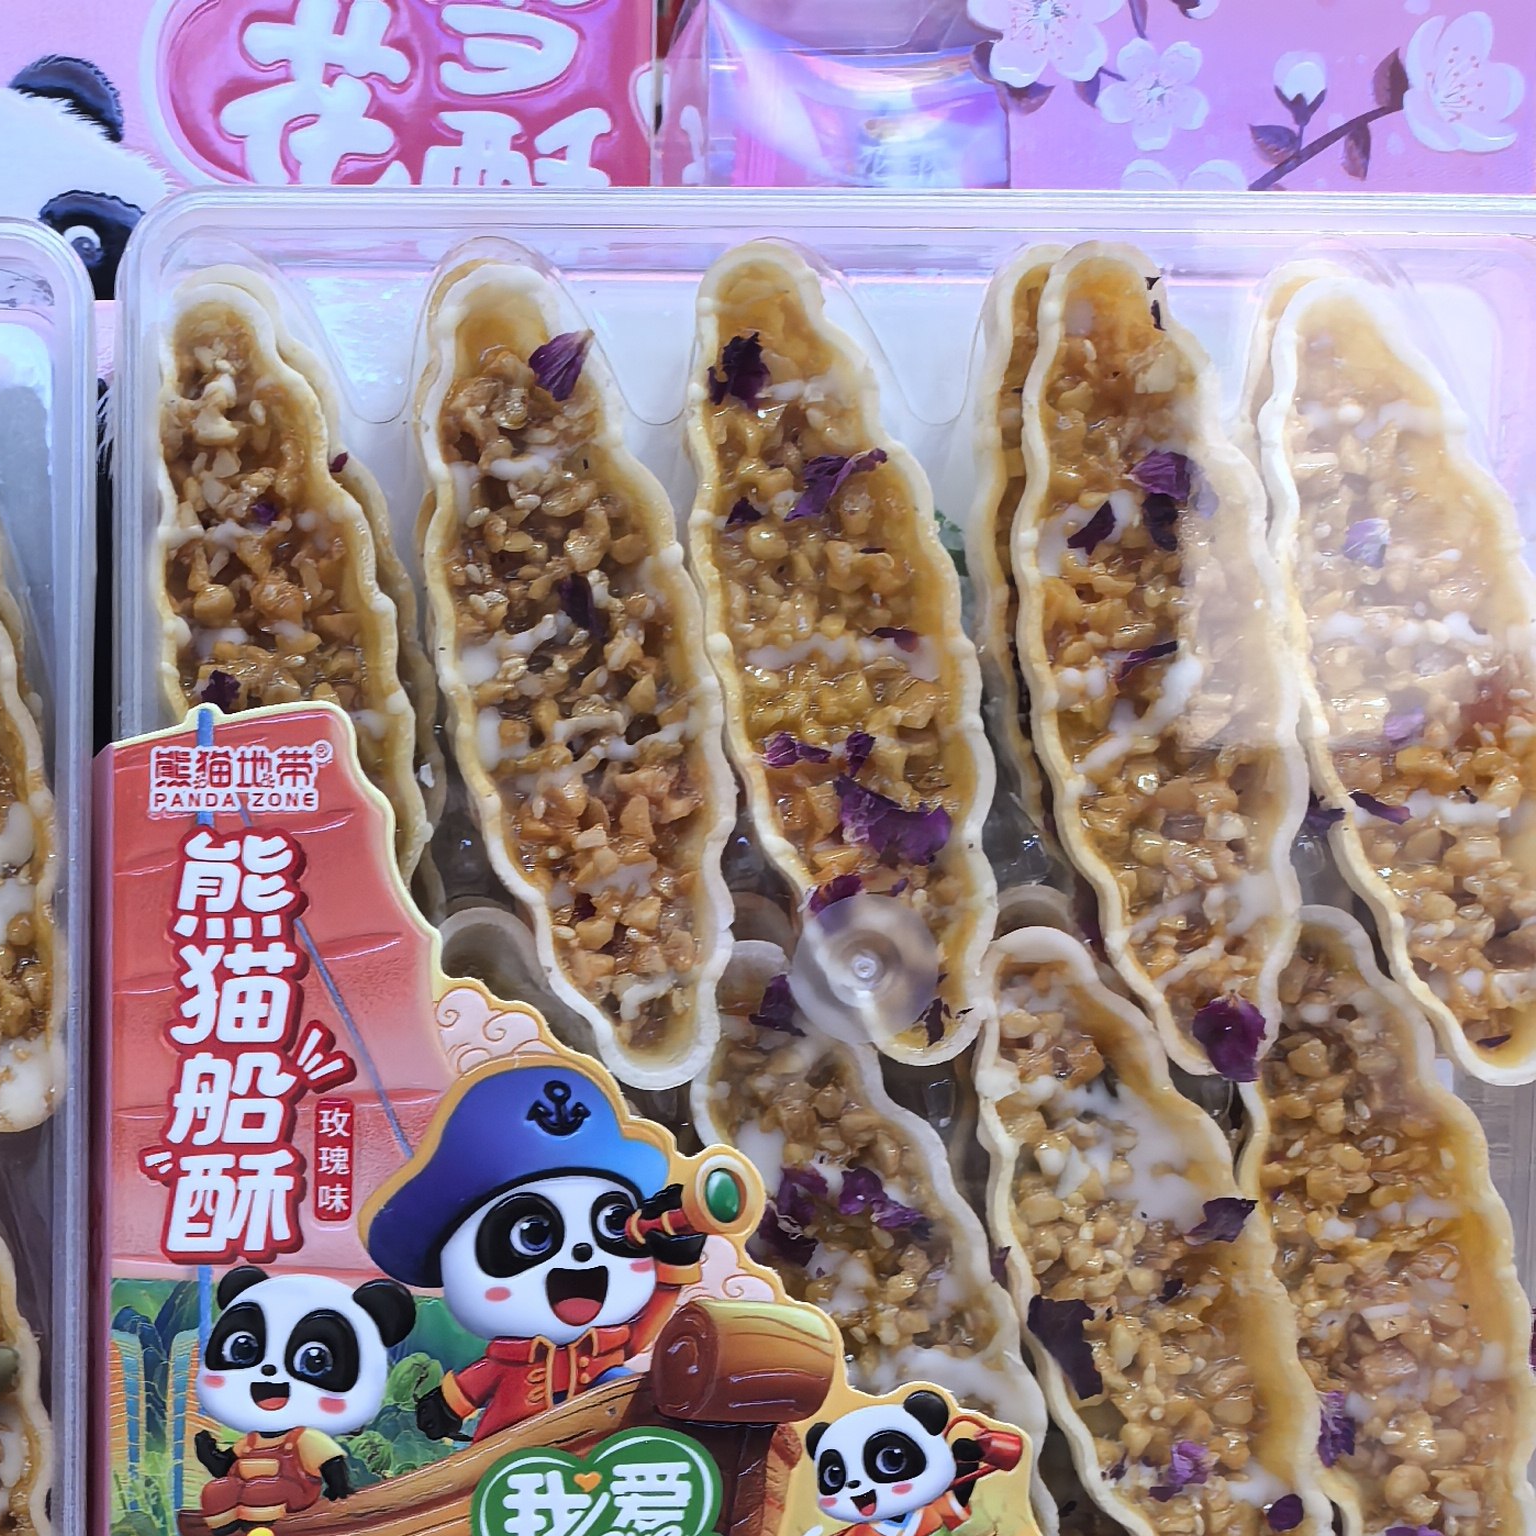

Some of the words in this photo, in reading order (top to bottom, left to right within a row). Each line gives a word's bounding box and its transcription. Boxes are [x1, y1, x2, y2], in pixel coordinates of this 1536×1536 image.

[154, 792, 237, 808] PANDA
[251, 792, 315, 808] ZONE
[165, 830, 298, 1254] 熊猫船酥
[317, 1107, 352, 1213] 玫瑰味
